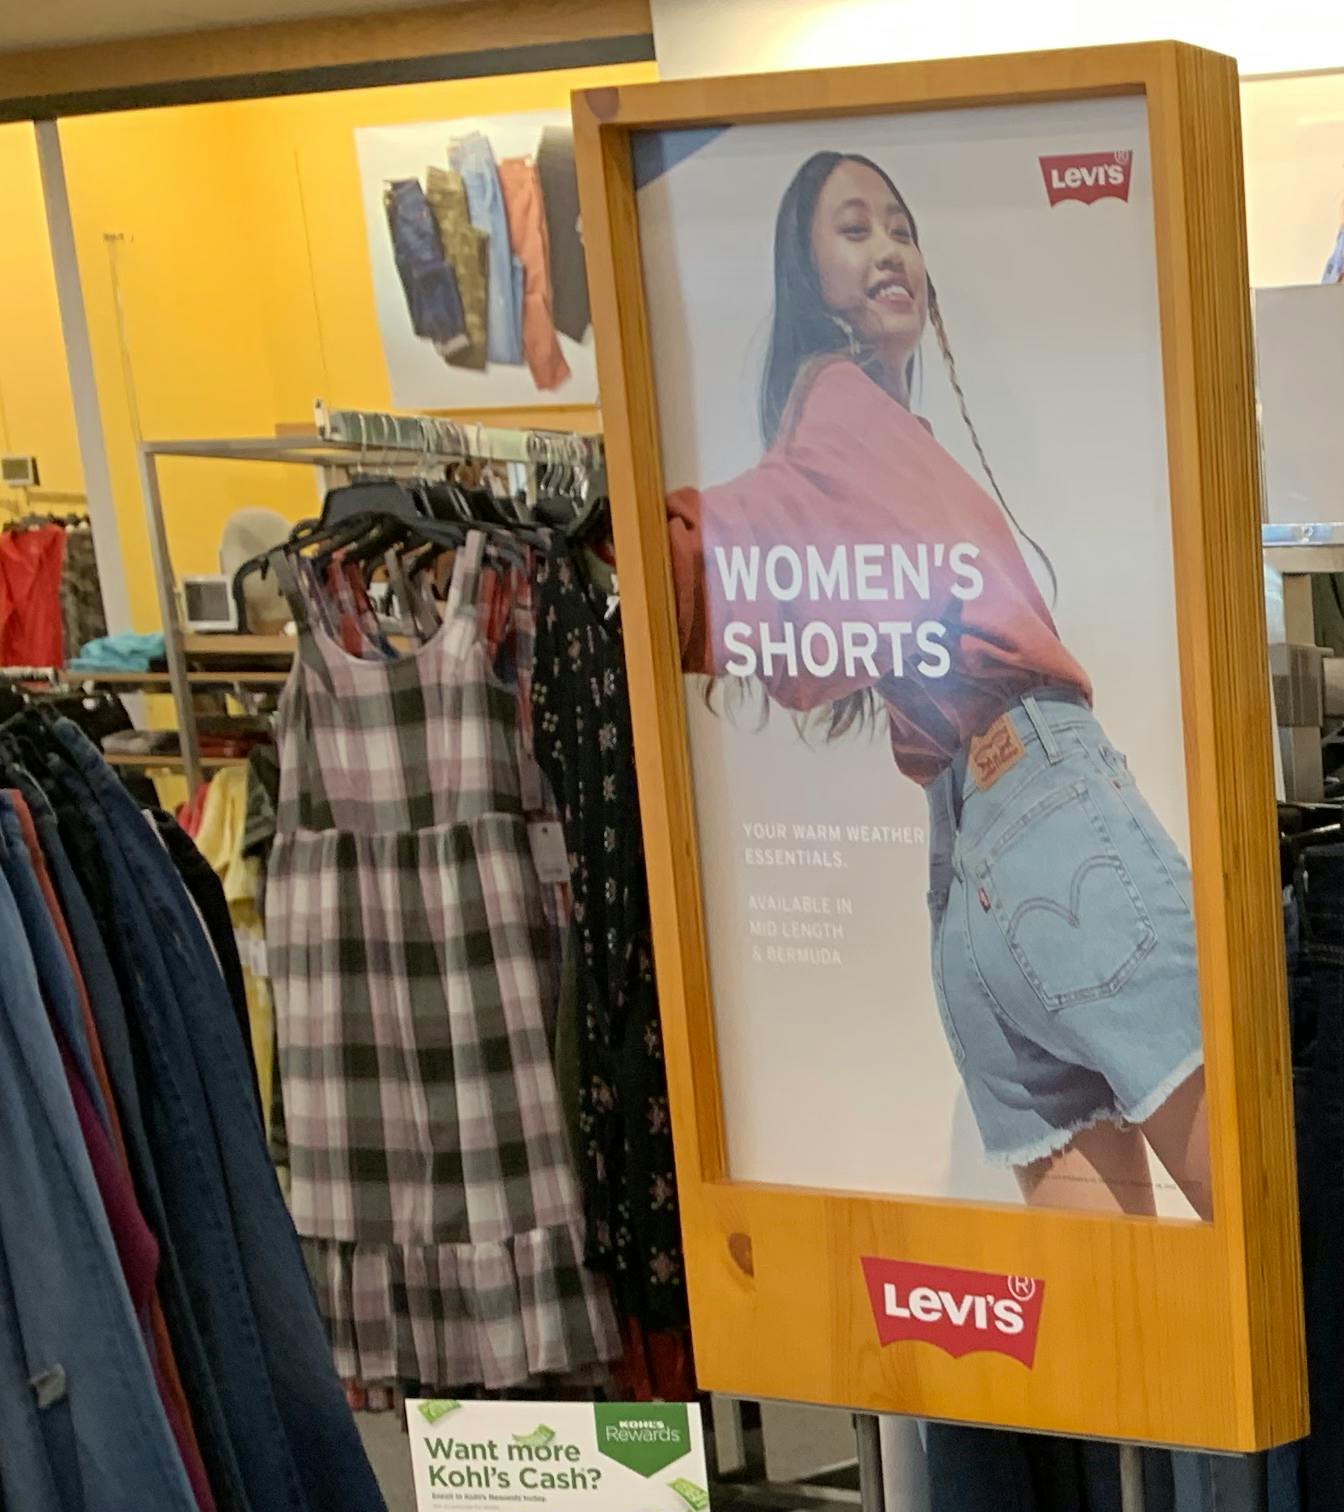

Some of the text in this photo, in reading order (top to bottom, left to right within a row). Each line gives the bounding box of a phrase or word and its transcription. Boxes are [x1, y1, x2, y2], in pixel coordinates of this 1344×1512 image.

[714, 542, 984, 602] WOMEN'S
[723, 620, 952, 678] SHORTS
[743, 822, 925, 845] YOUR WARM WEATHER
[749, 895, 853, 914] AVAILABLE IN
[750, 919, 844, 940] MID LENGTH
[766, 945, 842, 964] BERMUDA
[605, 1425, 680, 1442] Rewards
[619, 1420, 664, 1429] KOHL'S
[424, 1437, 580, 1463] Want more
[429, 1465, 601, 1491] Kohl's Cash?
